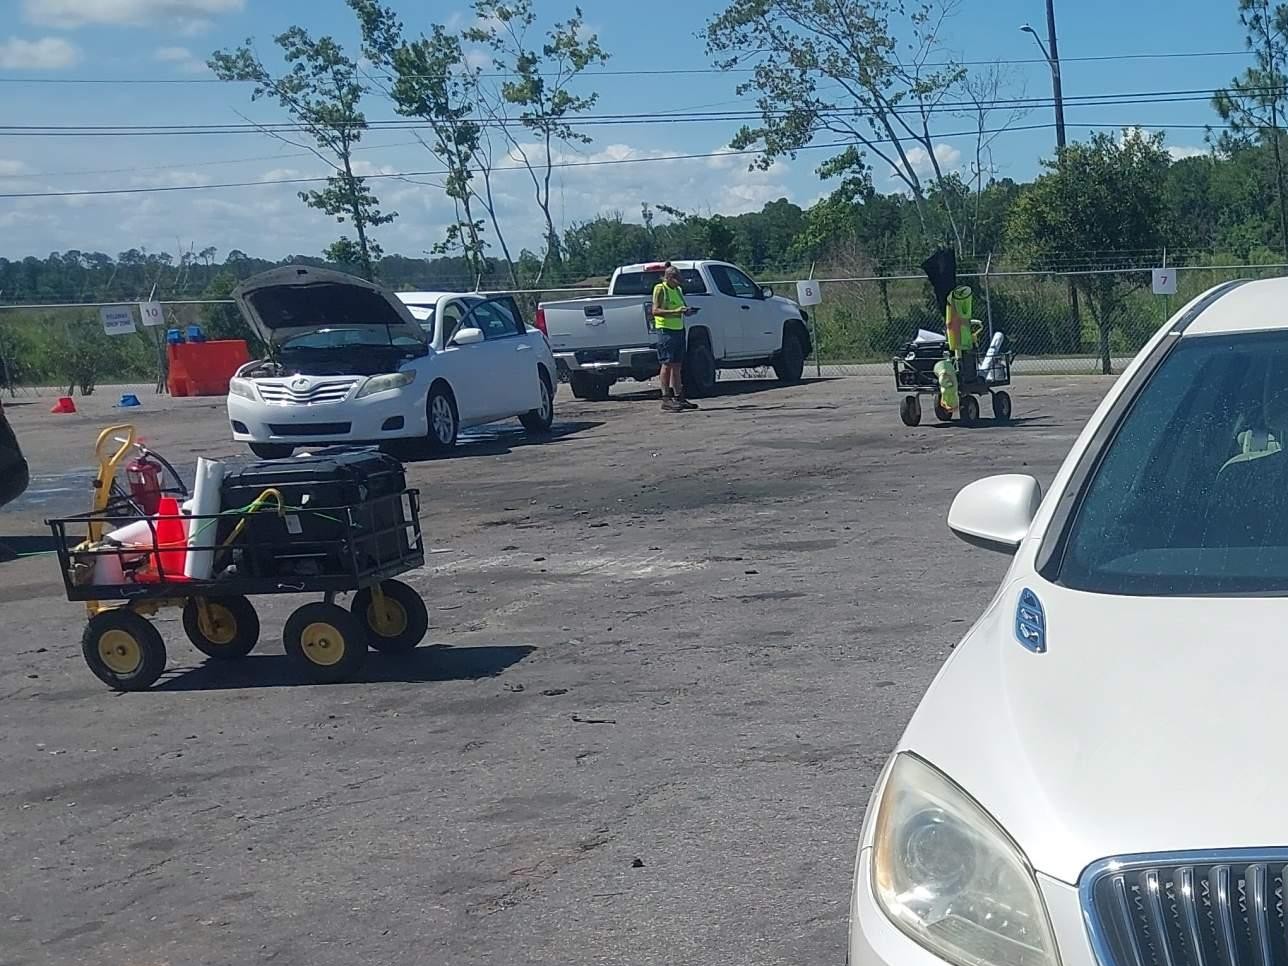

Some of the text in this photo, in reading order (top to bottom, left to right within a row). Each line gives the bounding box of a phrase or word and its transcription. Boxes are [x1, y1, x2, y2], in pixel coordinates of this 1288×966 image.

[1160, 276, 1168, 285] 7
[805, 287, 813, 297] 8
[146, 309, 158, 317] 10
